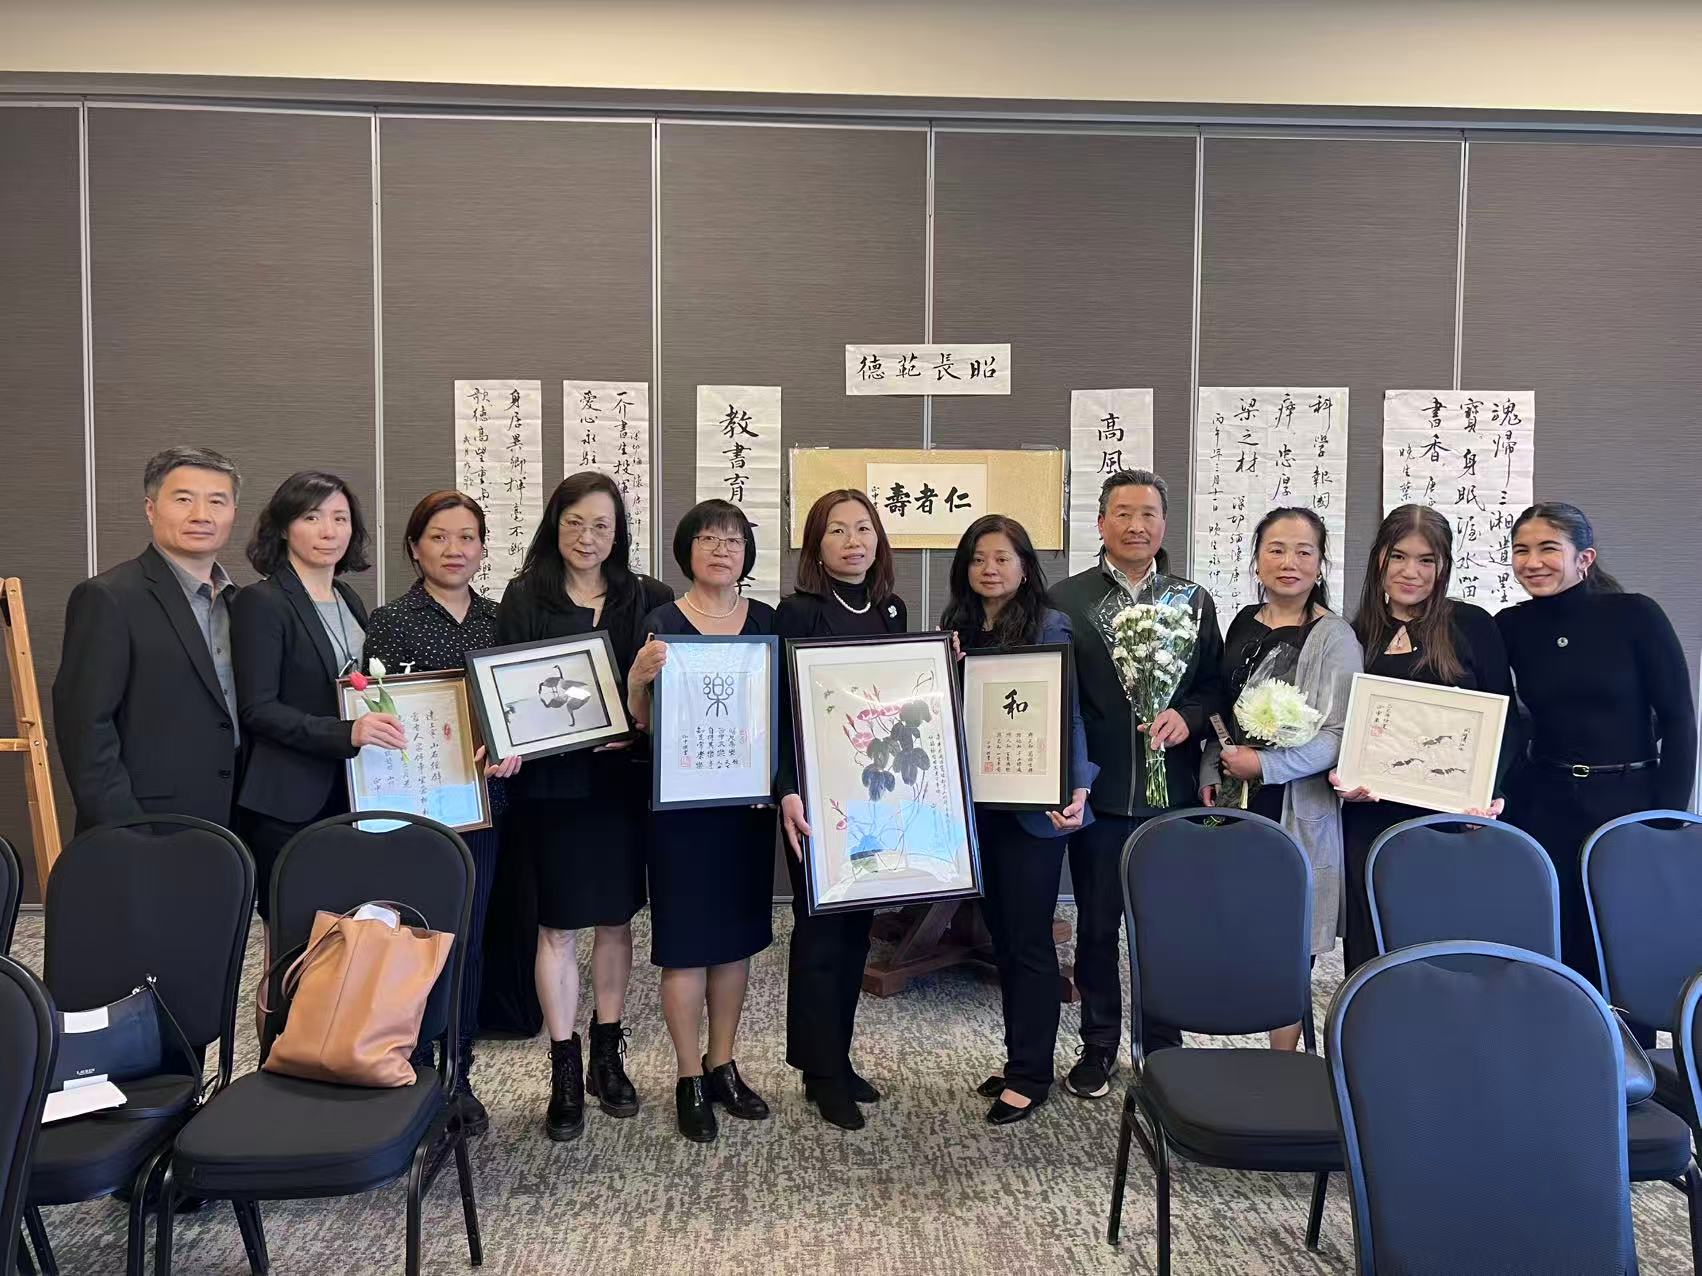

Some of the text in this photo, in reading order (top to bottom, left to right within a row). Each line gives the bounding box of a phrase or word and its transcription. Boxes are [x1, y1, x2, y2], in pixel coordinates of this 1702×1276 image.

[857, 352, 997, 381] 德範長昭
[719, 404, 760, 527] 教書育
[1003, 688, 1029, 720] 和
